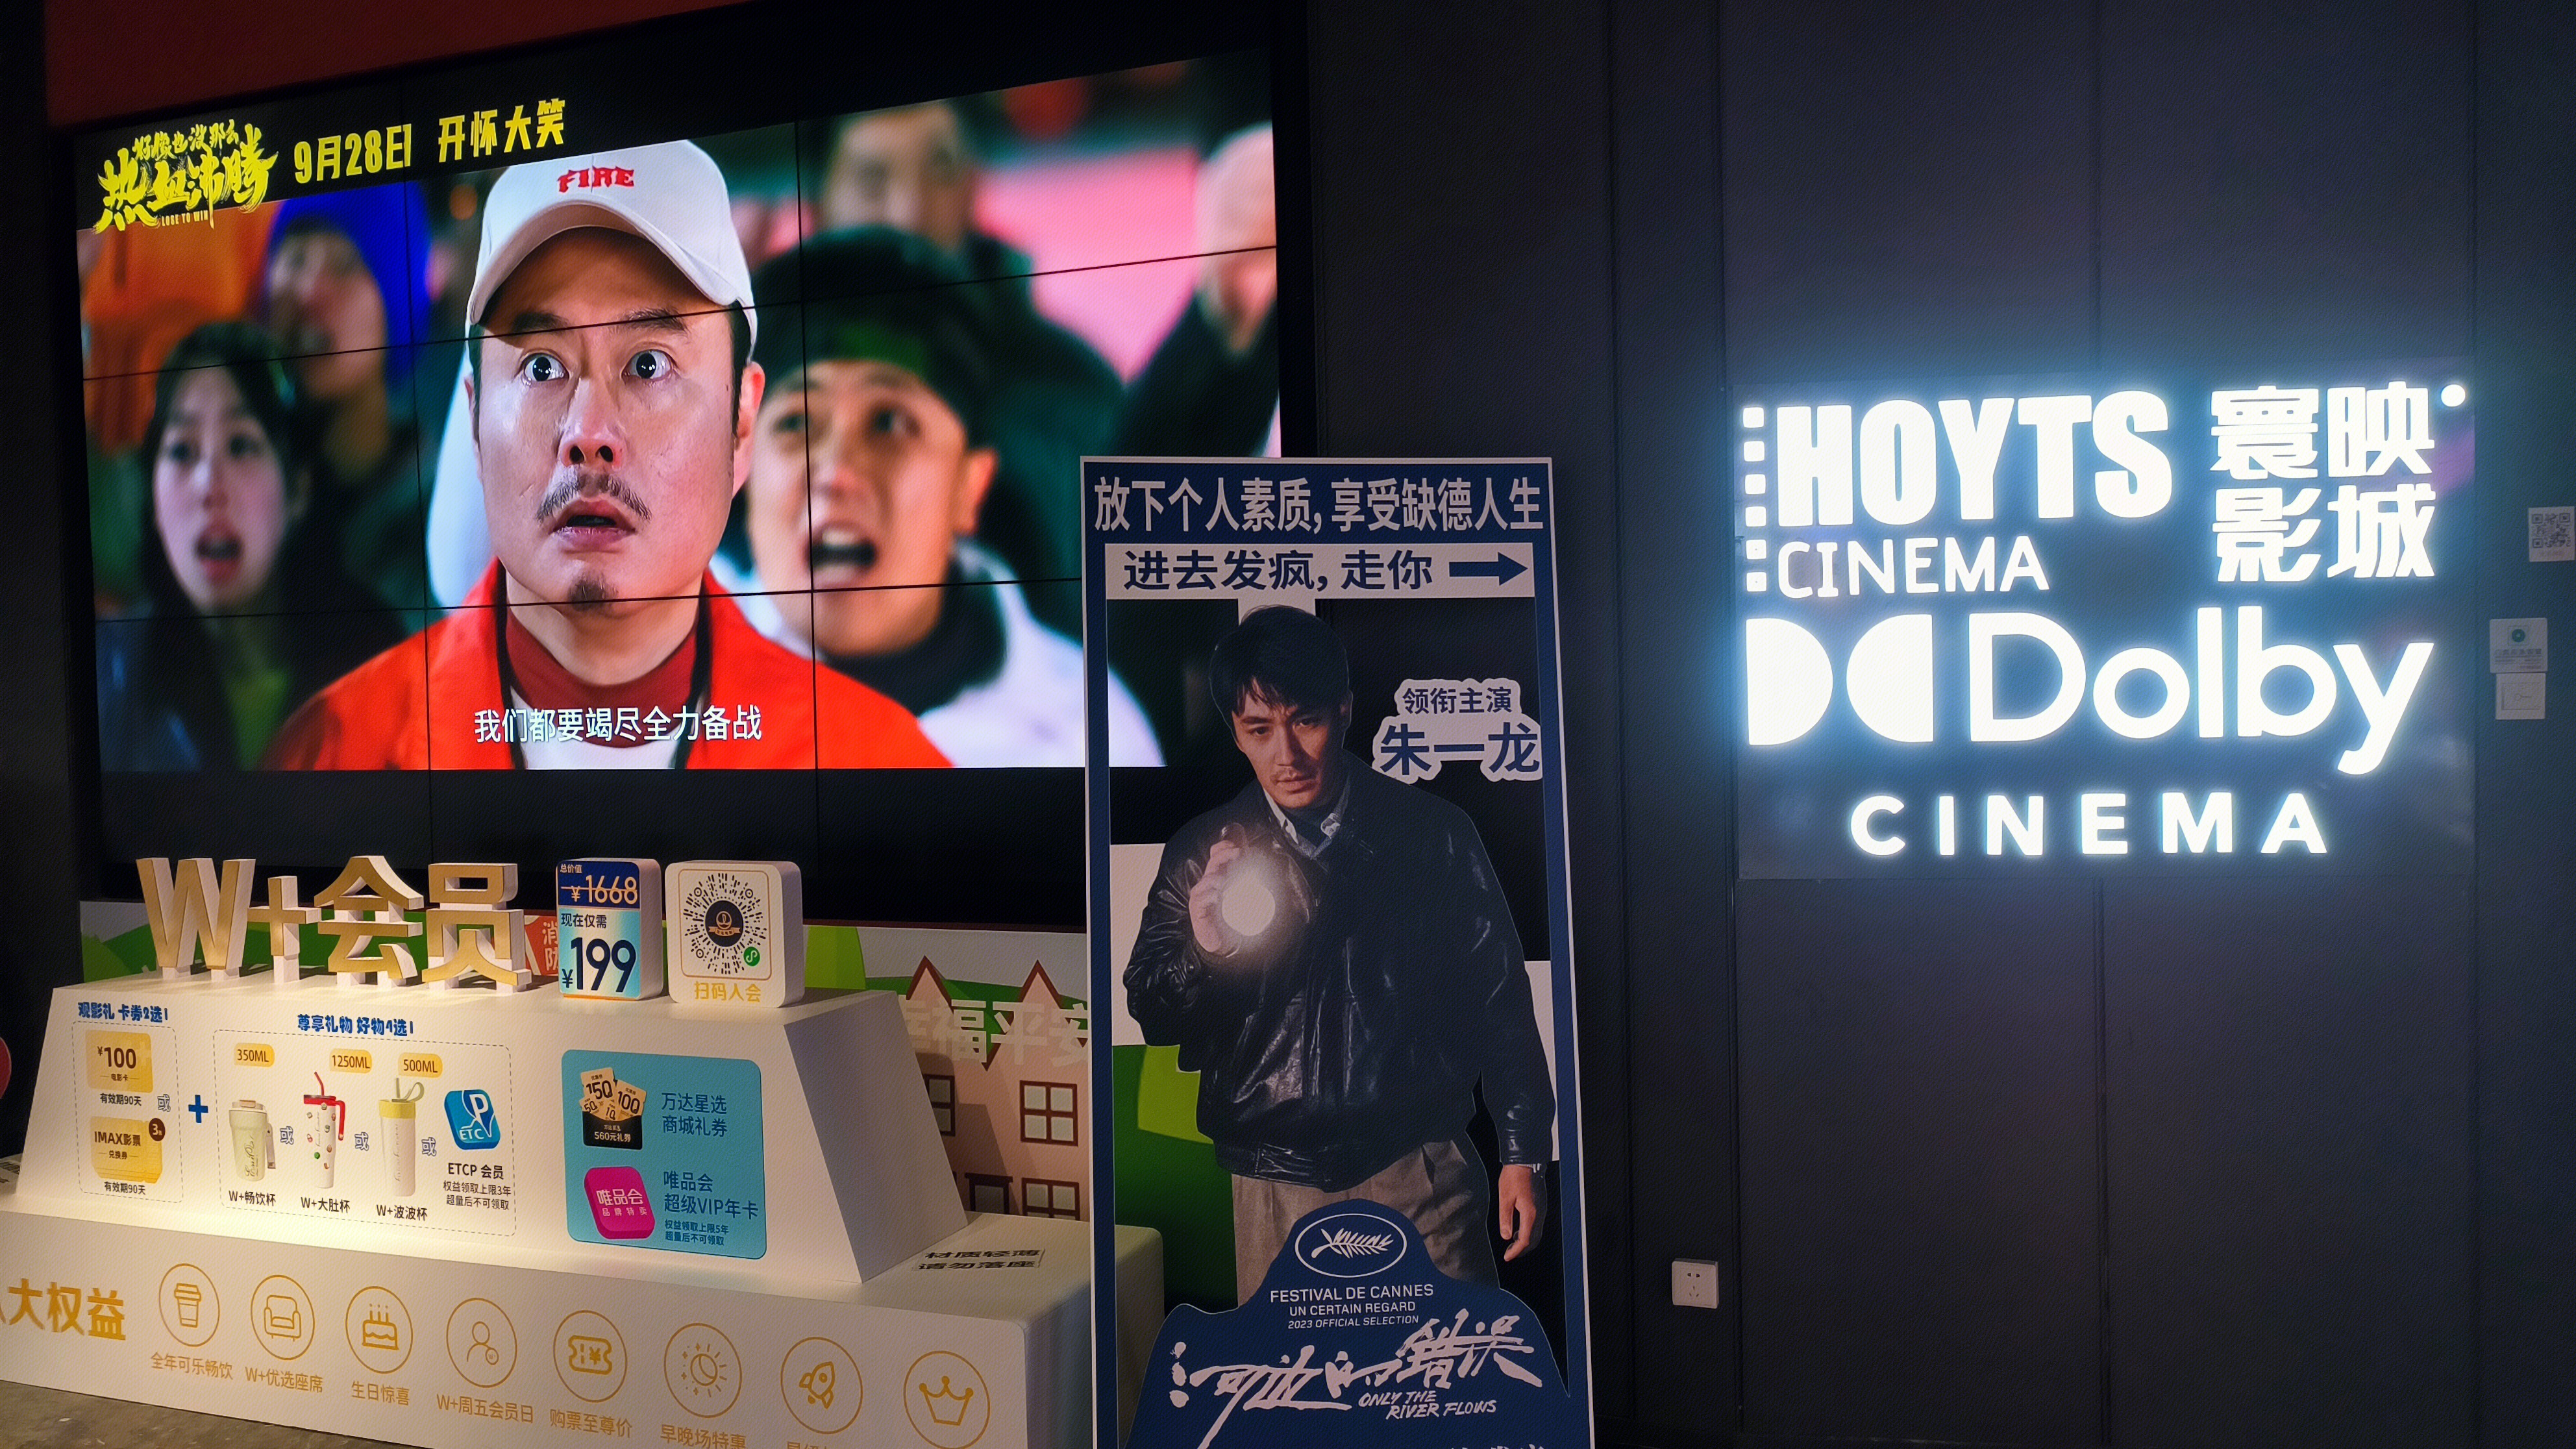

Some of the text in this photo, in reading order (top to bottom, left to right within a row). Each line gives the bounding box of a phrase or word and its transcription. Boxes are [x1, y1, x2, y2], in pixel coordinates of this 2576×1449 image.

[294, 98, 565, 184] 9月28日 开怀大笑
[92, 123, 278, 234] 热血沸腾
[557, 166, 634, 193] FIRE
[162, 210, 208, 227] LOSE TO WIN
[2211, 381, 2435, 480] 寰映
[1776, 390, 2172, 526] HOYTS
[2211, 483, 2436, 582] 影城
[1778, 536, 2050, 599] CINEMA
[1402, 686, 1513, 715] 领衔主演
[1969, 605, 2434, 776] Dolby
[474, 704, 762, 743] 我们都要竭尽全力备战
[1380, 721, 1541, 775] 朱一龙
[1850, 792, 2327, 856] CINEMA
[560, 863, 582, 874] 总价值
[136, 855, 532, 986] W+会员
[561, 913, 606, 929] 现在仅需
[562, 937, 636, 993] ¥199
[78, 1002, 115, 1020] 观影礼
[297, 1014, 353, 1034] 尊享礼物
[237, 1049, 269, 1063] 350ML
[332, 1055, 371, 1069] 1250ML
[403, 1059, 438, 1073] 500ML
[100, 1093, 142, 1106] 有效期90天
[157, 1094, 171, 1112] 或
[662, 1092, 727, 1115] 万达星选
[280, 1126, 294, 1145] 或
[662, 1115, 728, 1137] 商城礼券
[94, 1131, 141, 1146] IMAX影票
[354, 1132, 369, 1151] 或
[421, 1137, 437, 1157] 或
[594, 1132, 631, 1143] 560元礼券
[448, 1163, 504, 1180] ETCP 会员
[663, 1170, 713, 1193] 唯品会
[105, 1181, 146, 1195] 有效期90天
[229, 1190, 276, 1206] W+畅饮杯
[443, 1180, 512, 1196] 权益领取上限3年
[596, 1188, 643, 1206] 唯品会
[301, 1197, 350, 1213] W+大肚杯
[377, 1204, 428, 1221] W+波波杯
[446, 1195, 509, 1210] 超量后不可领取
[664, 1193, 759, 1220] 超级VIP年卡
[665, 1219, 729, 1234] 权益领取上限5年
[665, 1231, 724, 1246] 超量后不可领取
[1270, 1283, 1433, 1303] FESTIVAL DE CANNES
[0, 1278, 126, 1340] 大权益
[1289, 1301, 1416, 1317] UN CERTAIN REGARD
[1288, 1315, 1419, 1329] 2023 OFFICIAL SELECTION
[151, 1352, 233, 1380] 全年可乐畅饮
[245, 1366, 323, 1393] W+优选座席
[351, 1380, 410, 1406] 生日惊喜
[1358, 1390, 1437, 1407] ONLY THE
[436, 1393, 533, 1424] W+周五会员日
[1385, 1400, 1497, 1420] RIVER FLOWS
[550, 1408, 632, 1439] 购票至尊价
